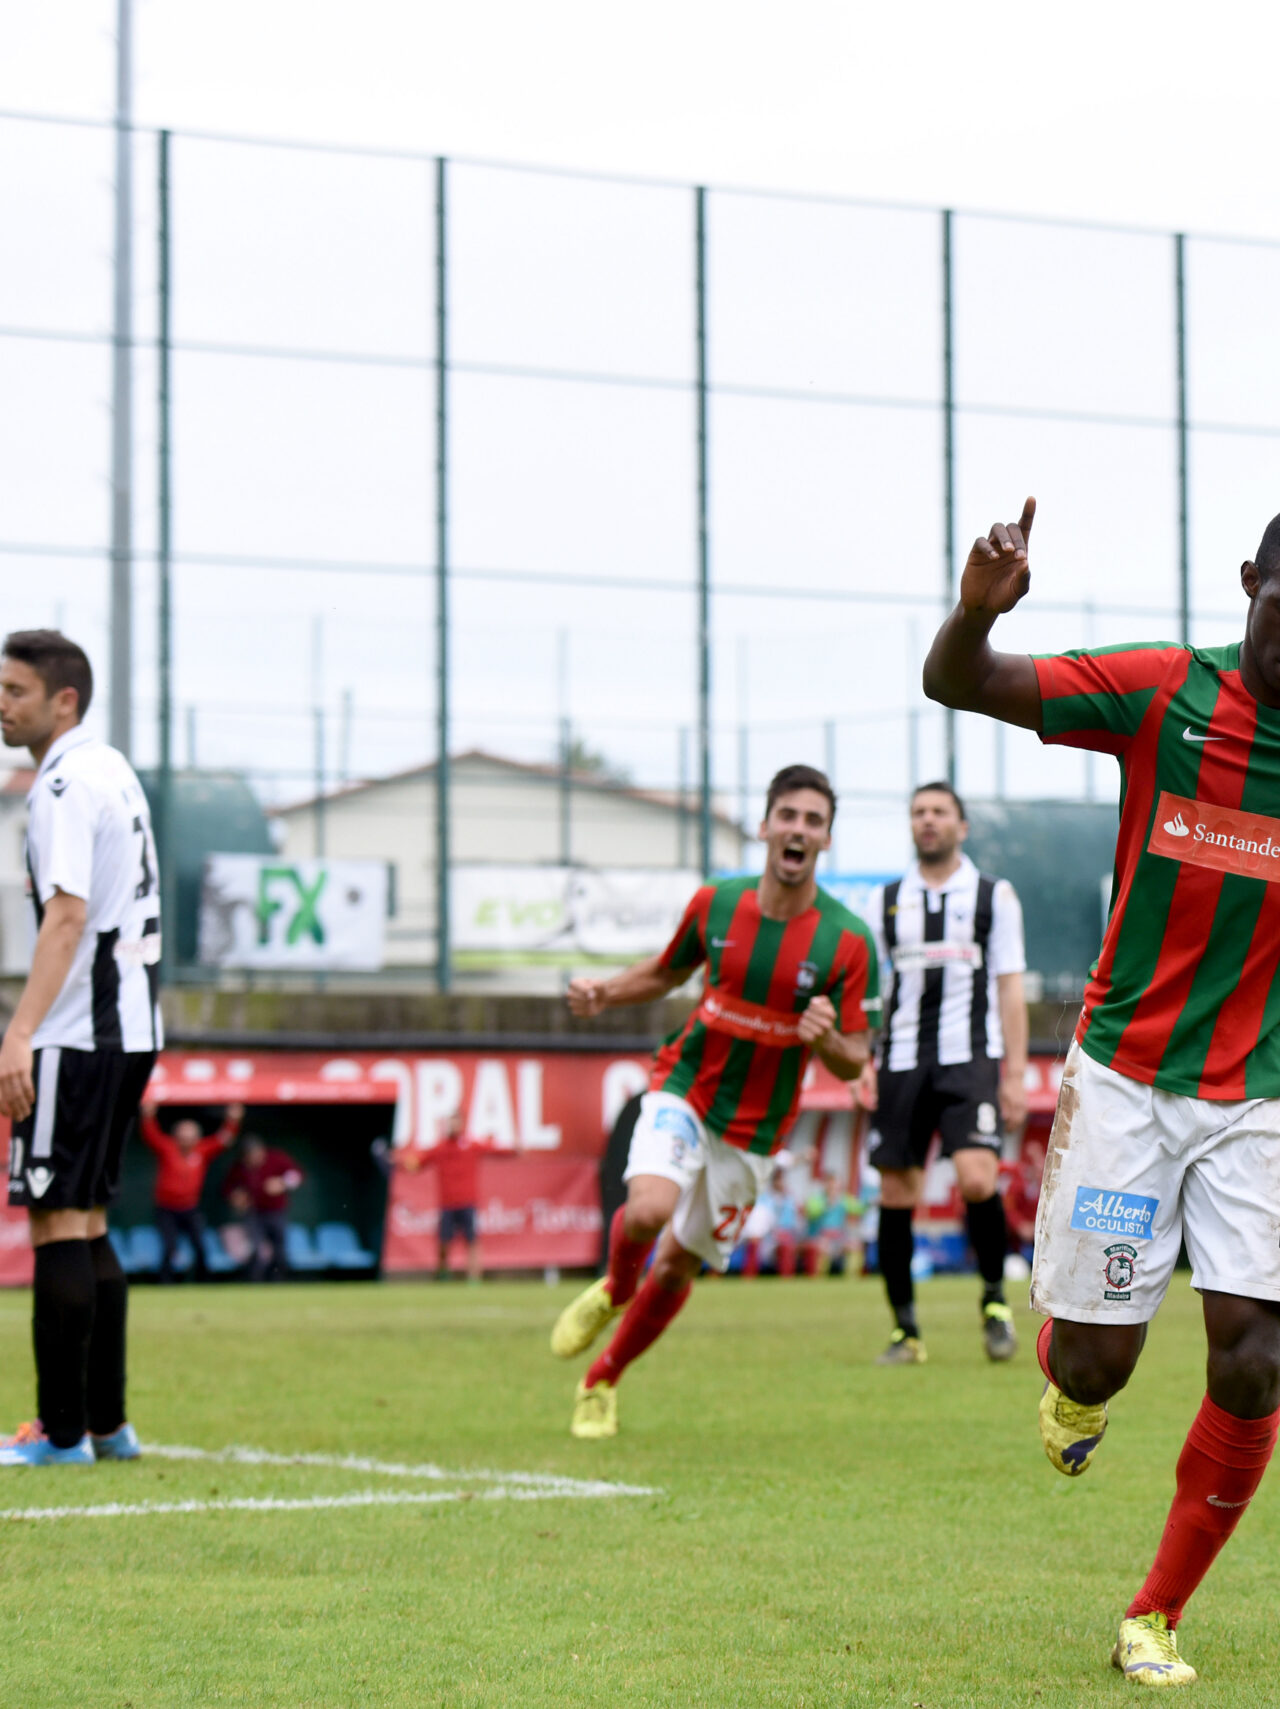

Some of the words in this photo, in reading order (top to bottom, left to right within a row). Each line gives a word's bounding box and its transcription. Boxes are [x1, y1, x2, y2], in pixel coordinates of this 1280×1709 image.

[257, 867, 327, 945] FX
[1079, 1193, 1151, 1223] Alberto
[1085, 1216, 1145, 1236] OCULISTA
